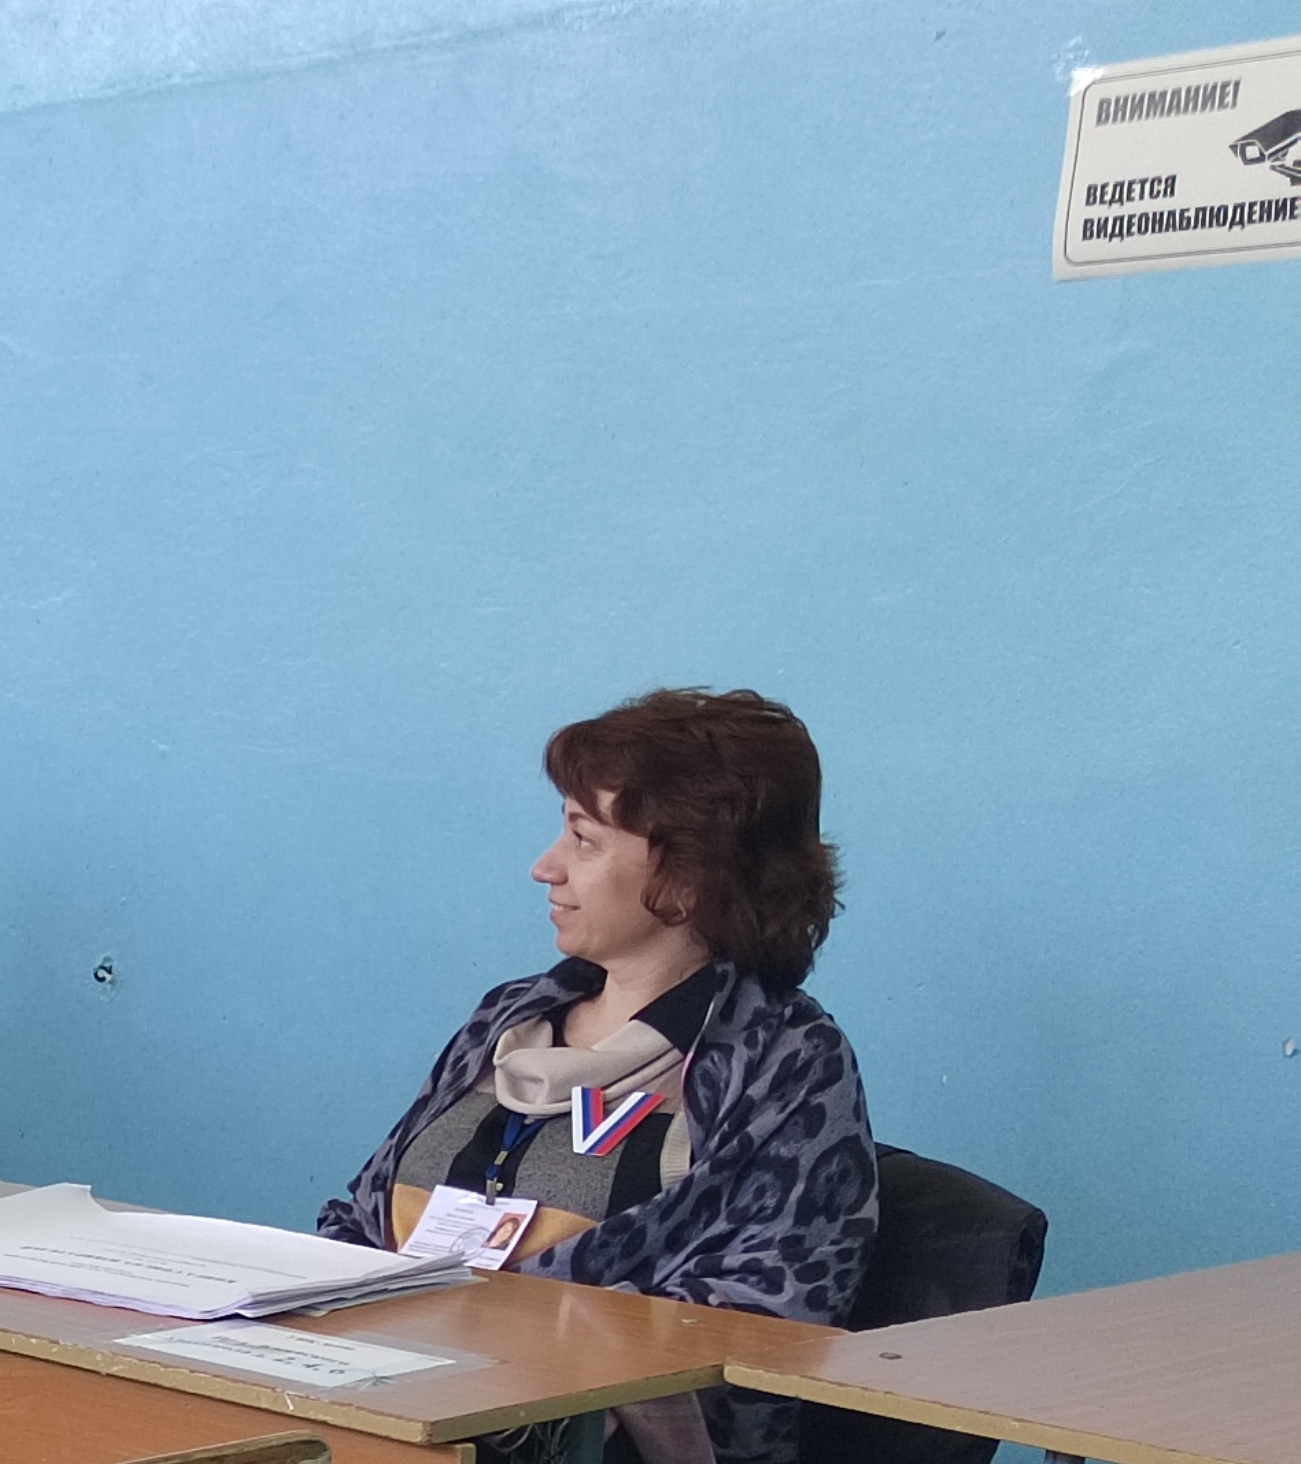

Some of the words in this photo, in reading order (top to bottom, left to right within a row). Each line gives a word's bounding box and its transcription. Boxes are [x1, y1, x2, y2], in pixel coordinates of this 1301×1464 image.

[1095, 79, 1241, 127] ВНИМАНИЕ!
[1084, 173, 1178, 208] ВЕДЕТСЯ
[1081, 196, 1301, 243] ВИДЕОНАБЛЮДЕНИЕ
